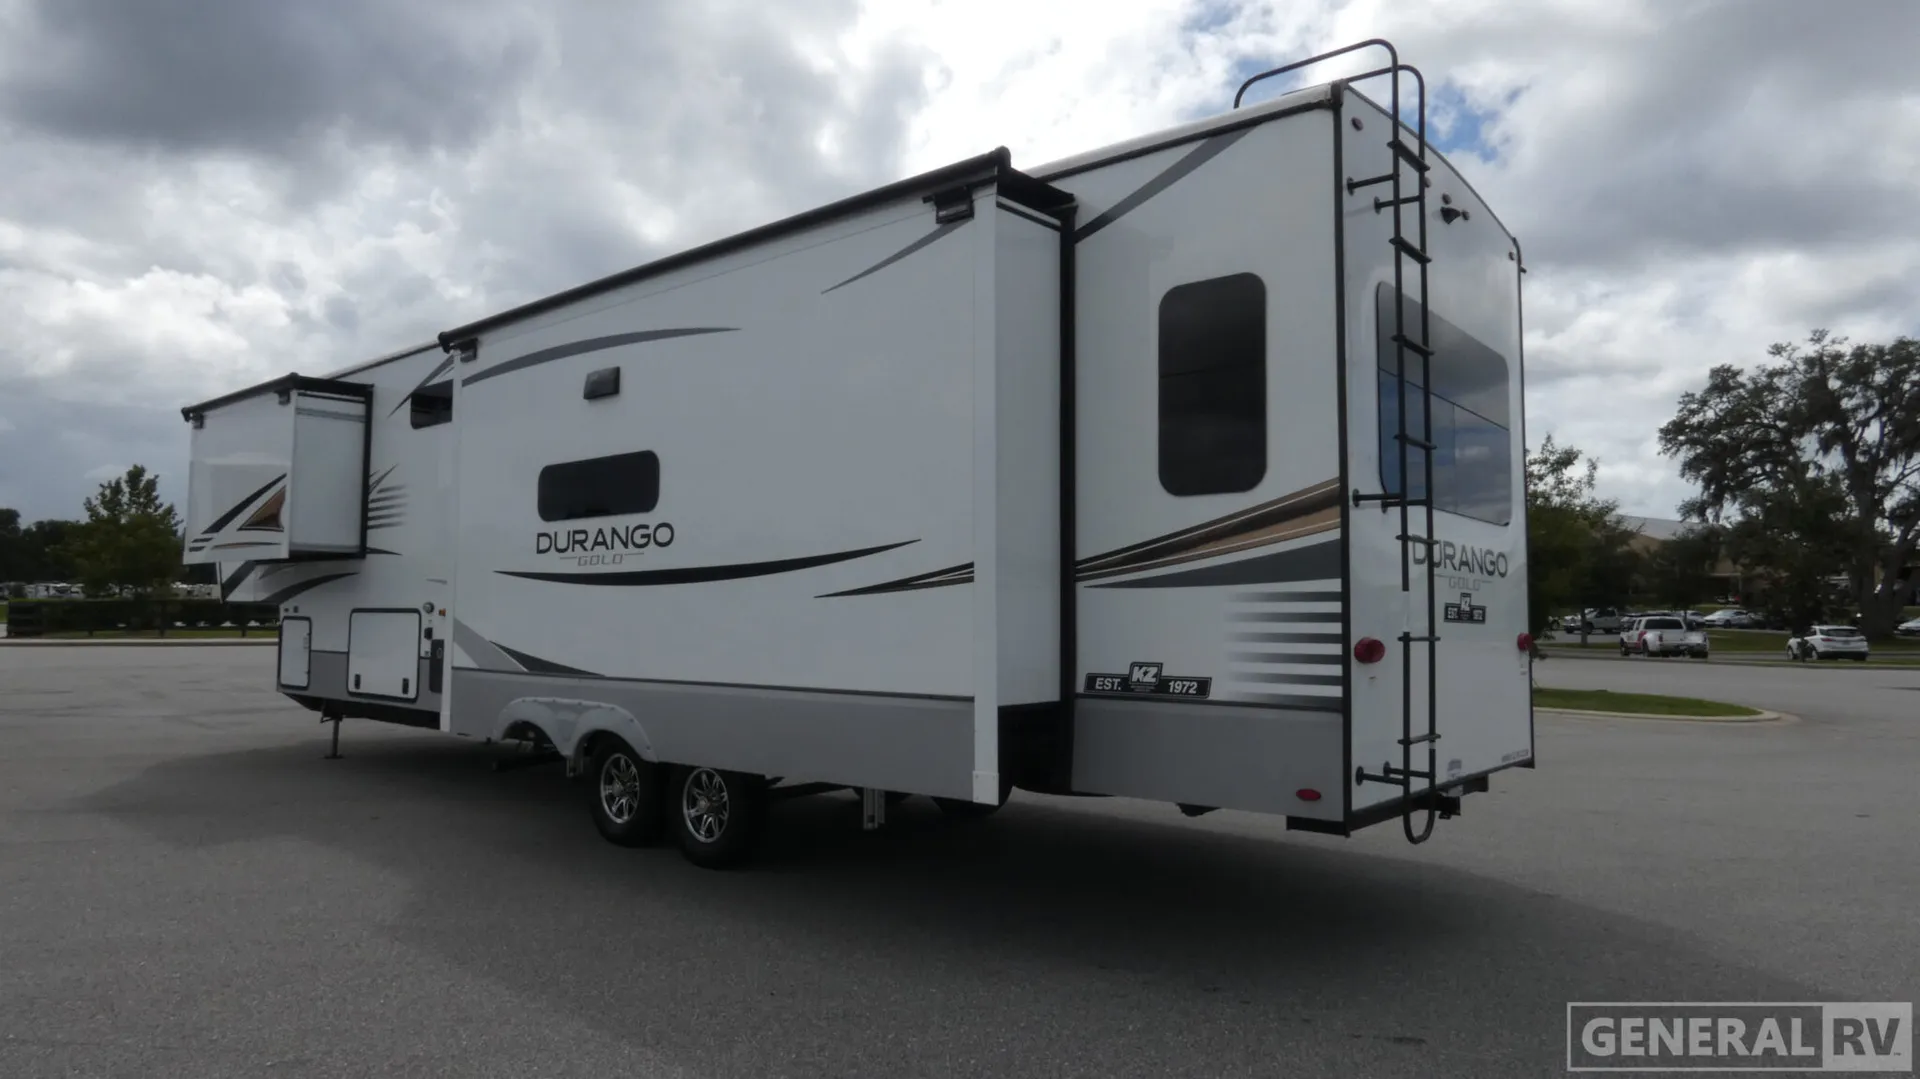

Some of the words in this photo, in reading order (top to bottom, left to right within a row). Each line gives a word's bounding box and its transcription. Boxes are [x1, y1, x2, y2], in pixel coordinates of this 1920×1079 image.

[537, 522, 674, 554] DURANGO
[577, 553, 623, 566] GOLD
[1131, 666, 1158, 682] KZ
[1095, 677, 1122, 691] EST.
[1168, 680, 1198, 694] 1972
